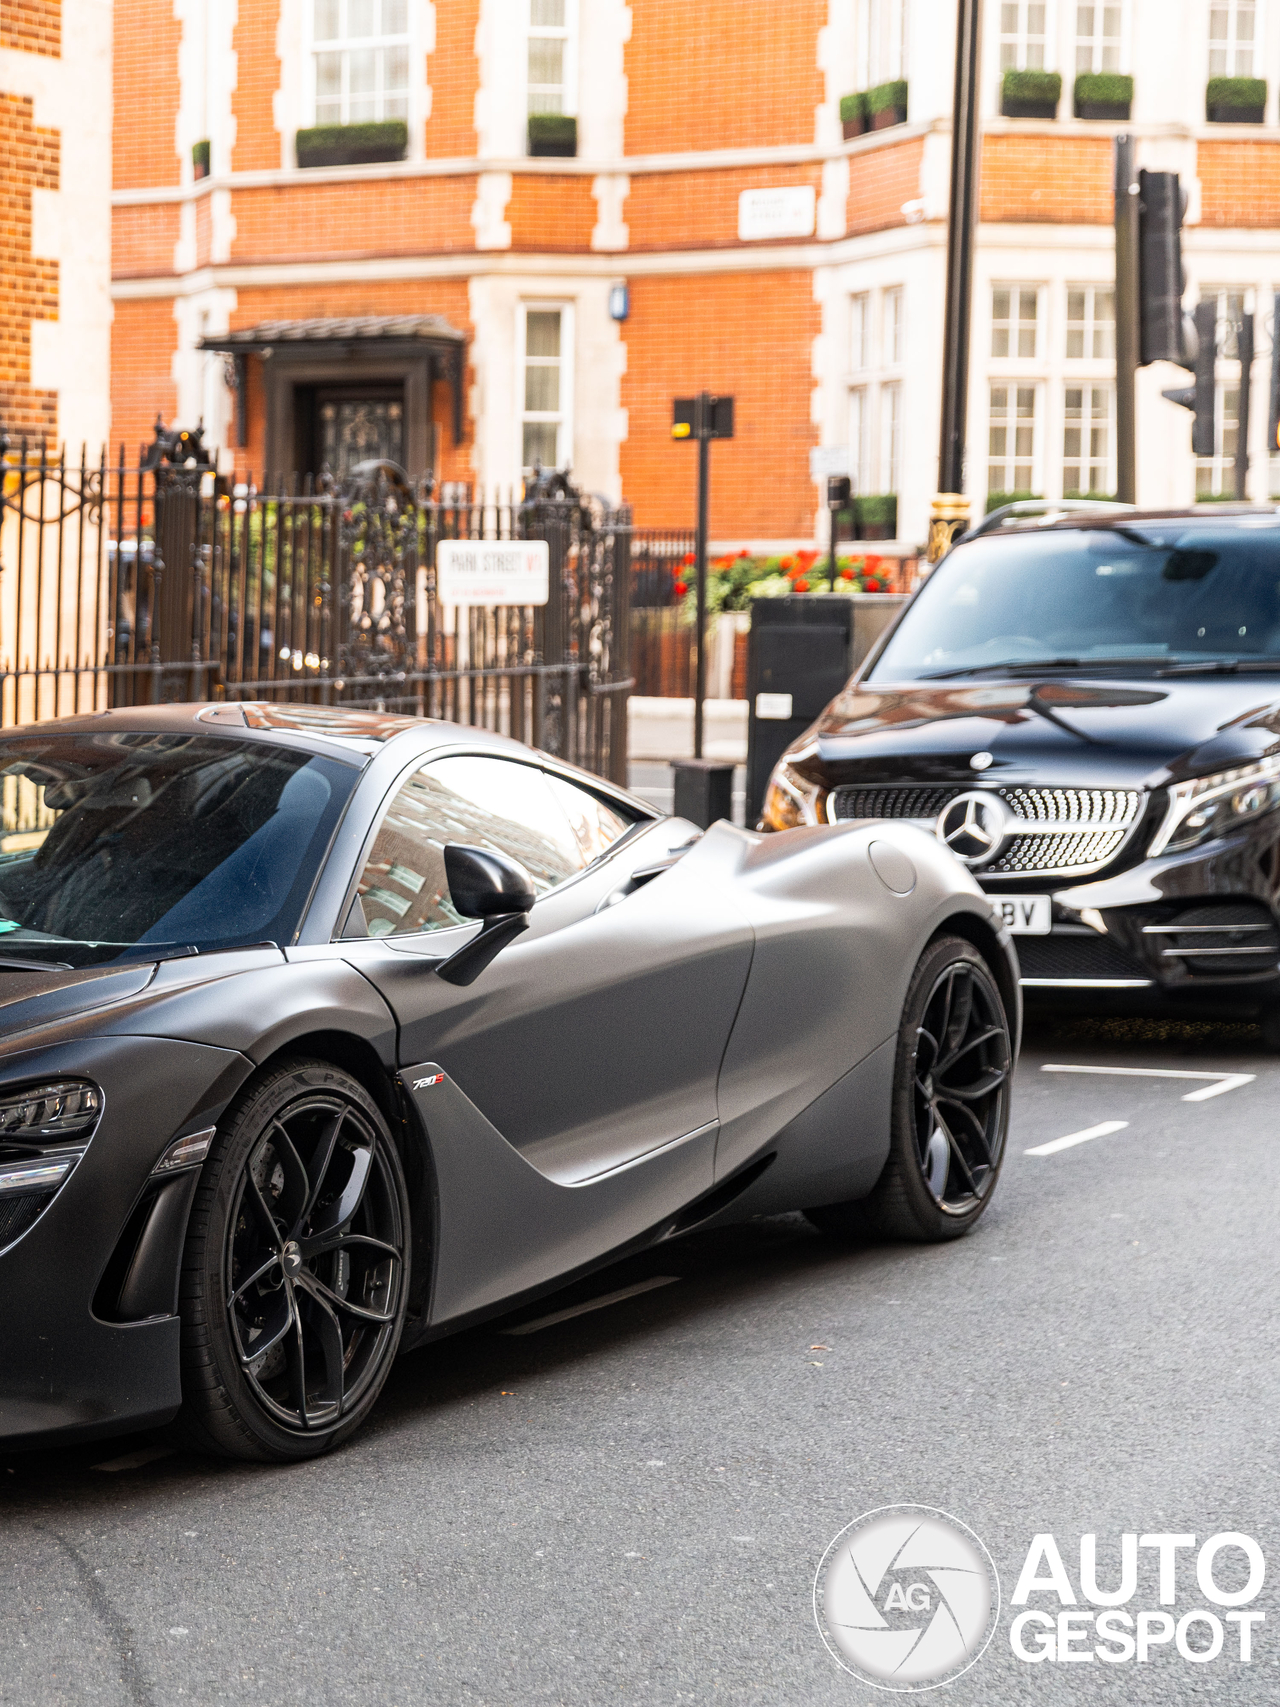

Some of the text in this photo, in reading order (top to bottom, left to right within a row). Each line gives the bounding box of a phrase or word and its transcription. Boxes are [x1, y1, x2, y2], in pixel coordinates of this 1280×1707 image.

[450, 551, 477, 573] PARK
[482, 551, 522, 573] STREET
[1001, 902, 1035, 926] BV
[412, 1072, 445, 1091] 720S
